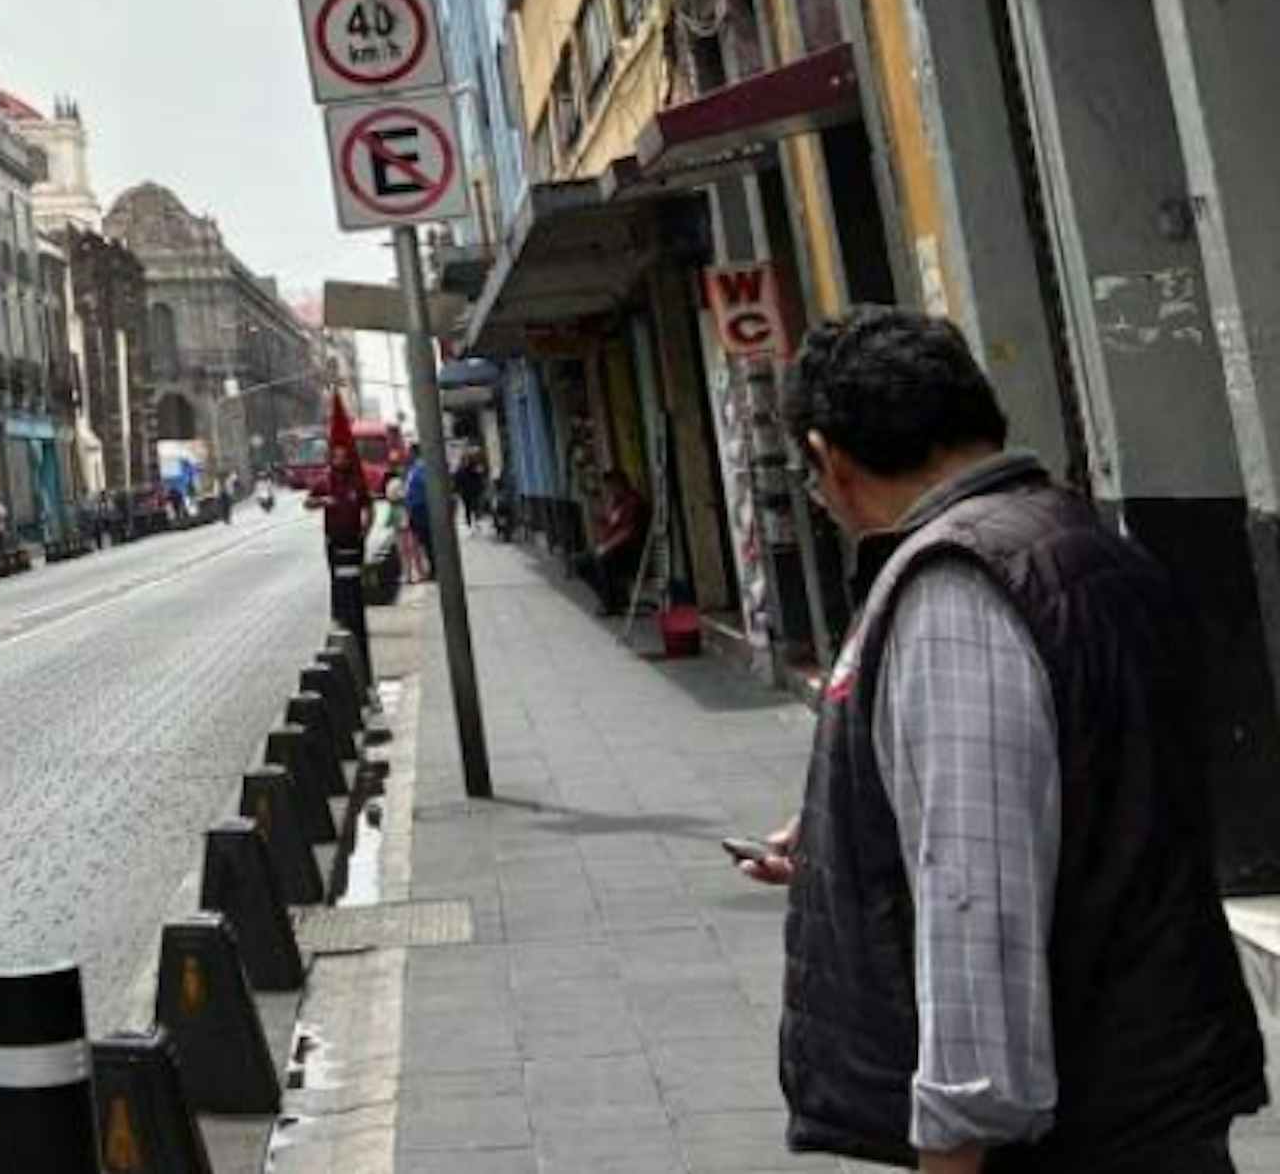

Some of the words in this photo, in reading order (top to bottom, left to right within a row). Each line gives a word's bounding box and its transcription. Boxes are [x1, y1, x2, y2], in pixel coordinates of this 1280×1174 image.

[347, 2, 394, 38] 40
[370, 127, 425, 196] E
[718, 271, 771, 345] WC
